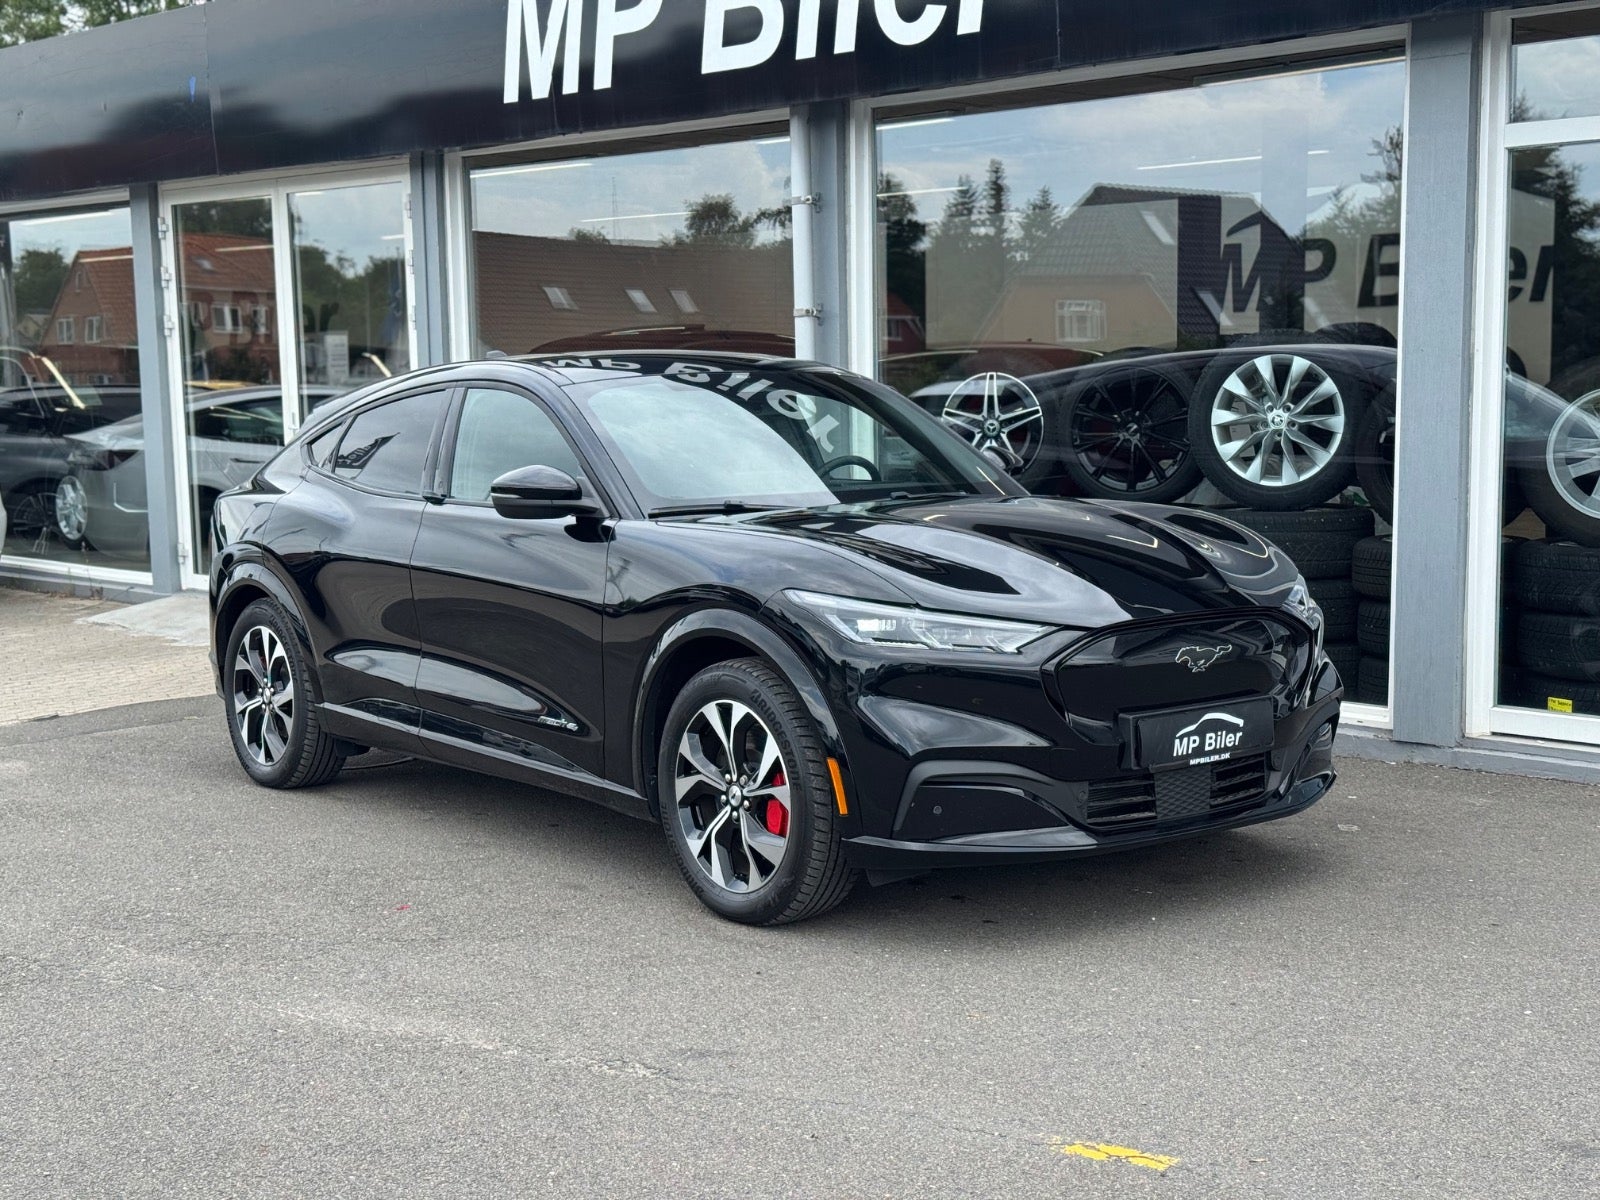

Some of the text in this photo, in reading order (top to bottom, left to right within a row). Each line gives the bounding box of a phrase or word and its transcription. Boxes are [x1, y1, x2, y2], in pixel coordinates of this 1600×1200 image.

[503, 0, 664, 104] MP
[751, 689, 801, 792] BRIDGESTONE
[1173, 730, 1243, 757] MP Biler
[1189, 752, 1231, 765] MPBILER.DK
